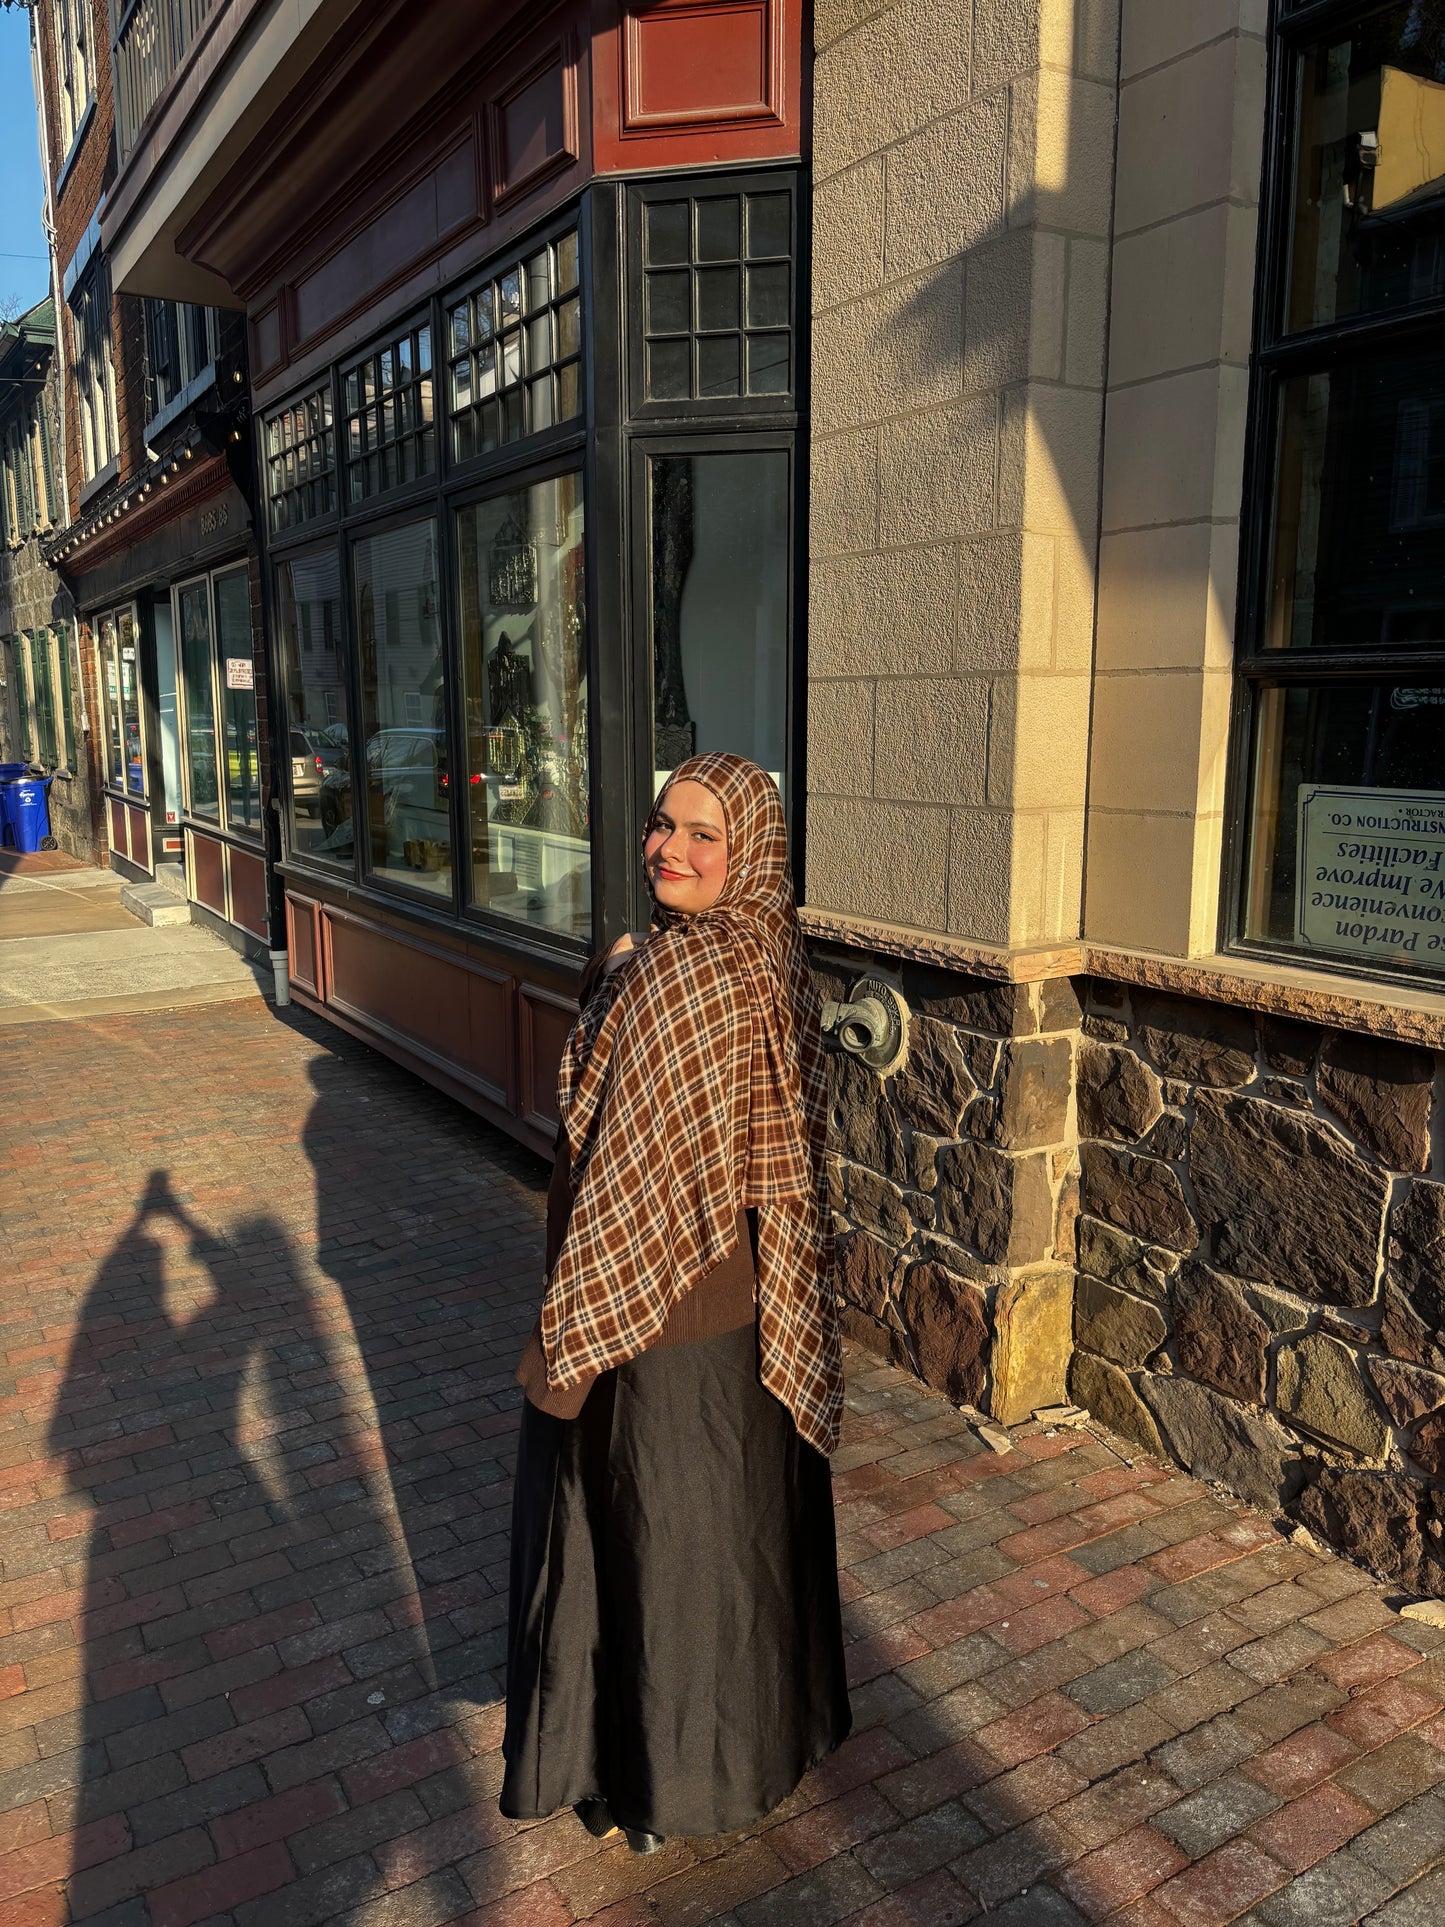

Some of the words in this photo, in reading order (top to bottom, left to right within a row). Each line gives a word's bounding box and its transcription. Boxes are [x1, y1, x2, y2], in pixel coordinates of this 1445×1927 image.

[1327, 813, 1352, 826] CO.
[1405, 807, 1445, 819] RACTOR
[1337, 842, 1443, 871] Facilities
[1316, 867, 1413, 895] Improve
[1335, 920, 1421, 951] Pardon
